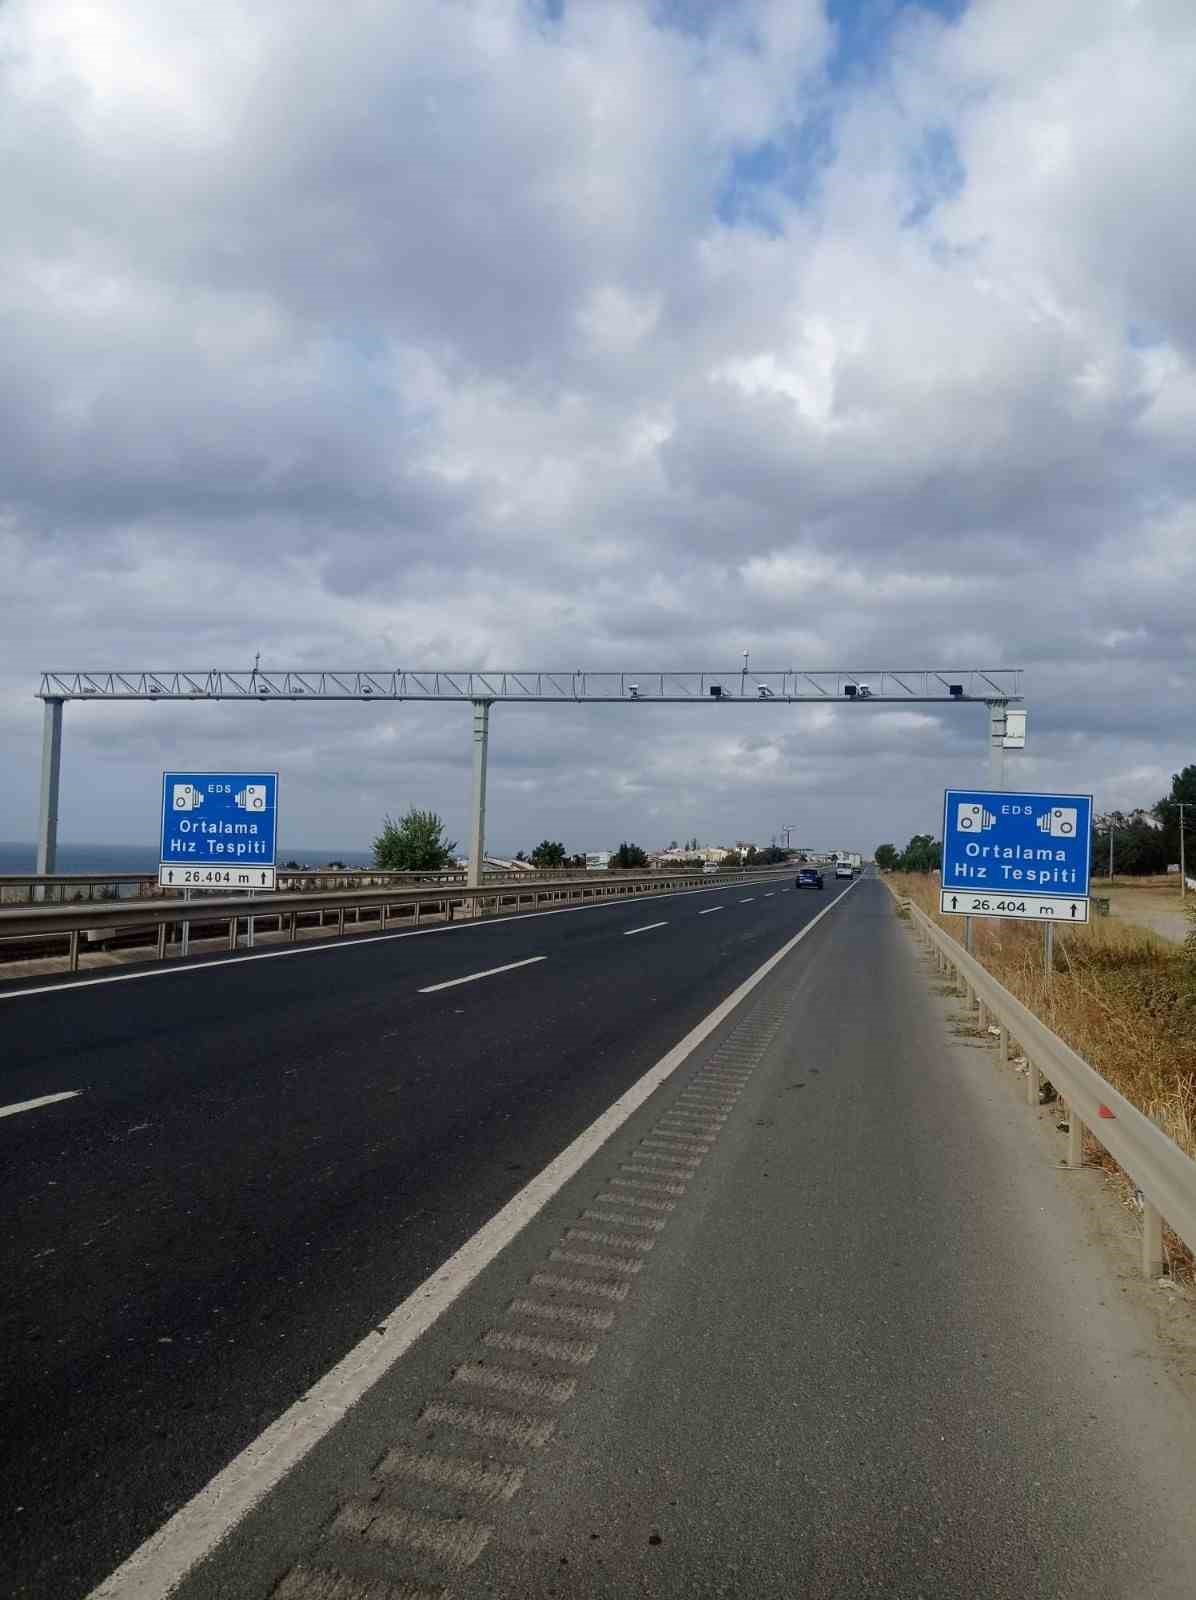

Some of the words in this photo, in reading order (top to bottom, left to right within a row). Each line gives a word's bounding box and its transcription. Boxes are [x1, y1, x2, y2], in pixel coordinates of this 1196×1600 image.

[208, 784, 231, 793] EDS
[1001, 805, 1032, 815] EDS
[179, 820, 258, 834] Ortalama
[170, 839, 196, 852] Hız
[207, 840, 265, 856] Tespiti
[966, 842, 1066, 861] Ortalama
[184, 871, 230, 882] 26.404
[238, 874, 249, 883] m
[955, 863, 987, 878] Hız
[1001, 865, 1076, 884] Tespiti
[971, 899, 1026, 913] 26.404
[1039, 906, 1054, 915] m
